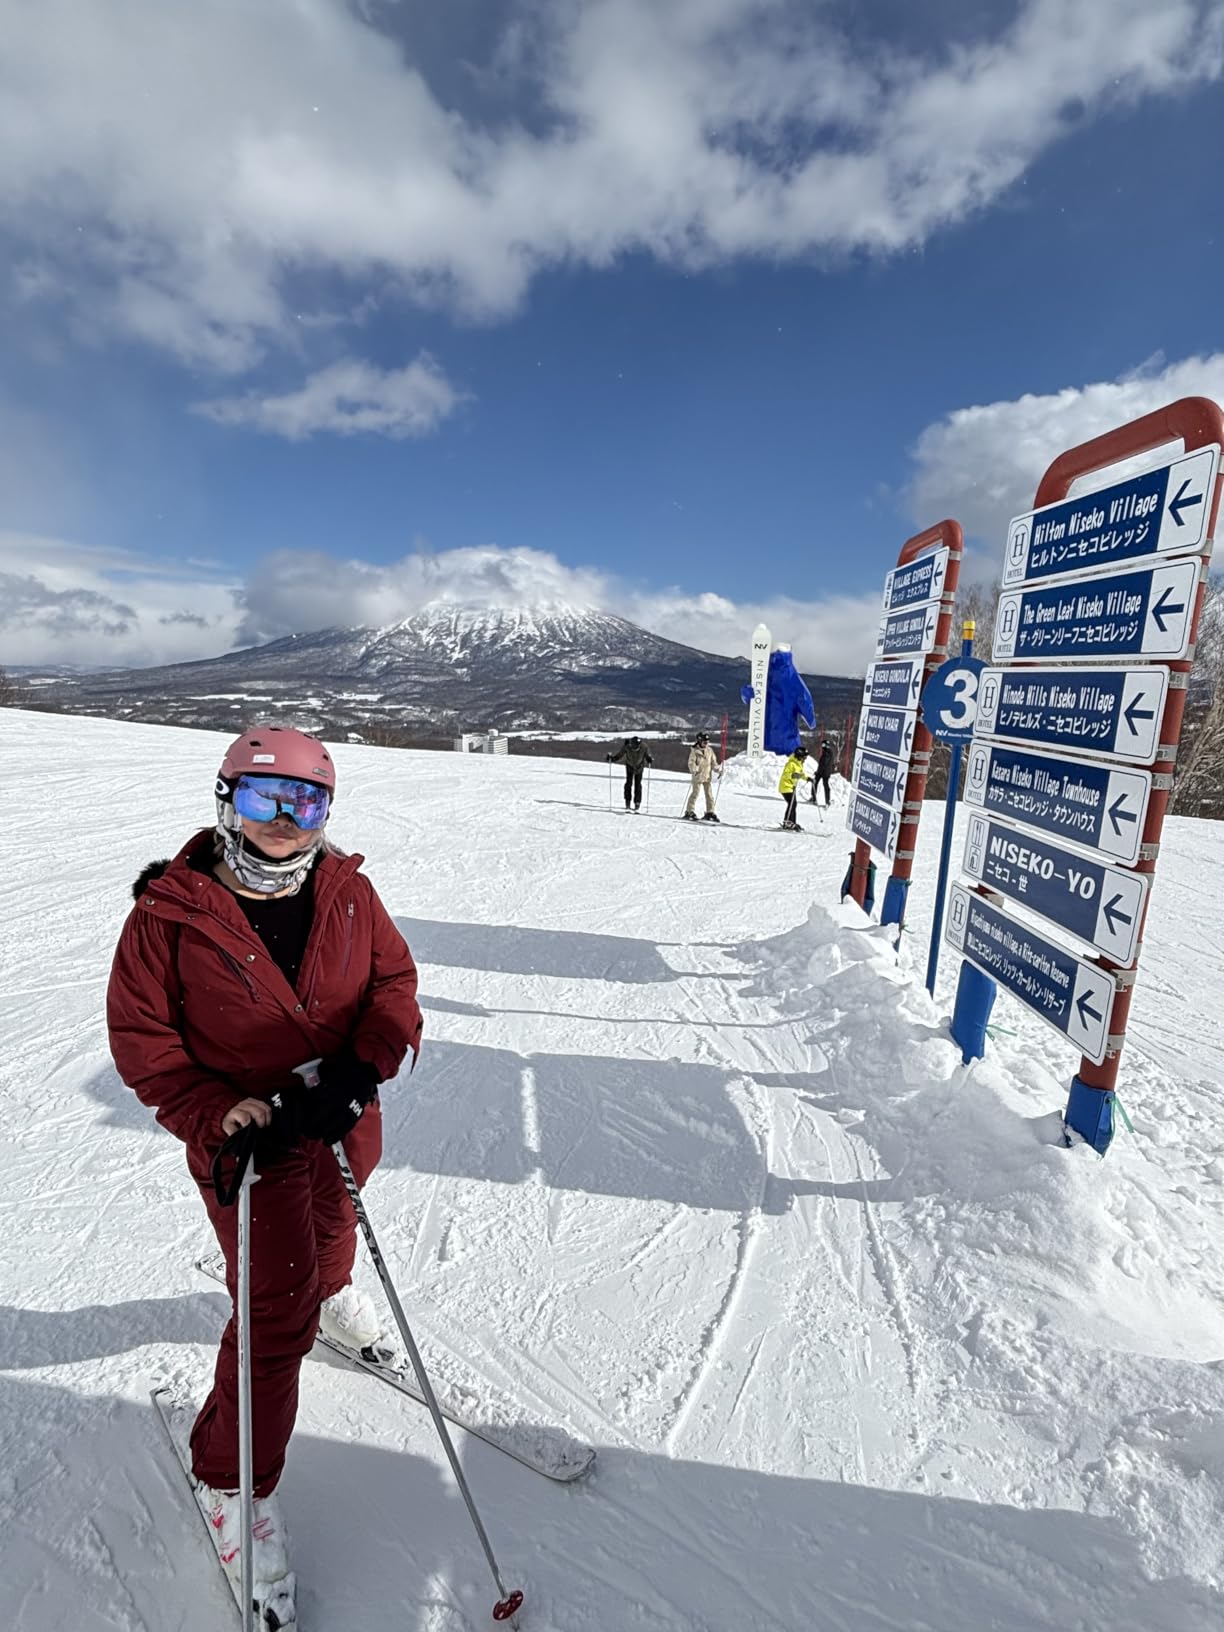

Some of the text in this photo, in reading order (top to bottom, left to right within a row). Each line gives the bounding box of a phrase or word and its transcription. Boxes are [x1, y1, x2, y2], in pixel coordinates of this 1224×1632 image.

[1033, 493, 1158, 546] Hilton Niseko Village
[1031, 521, 1149, 568] ヒルトンニセコビレッジ
[1023, 590, 1141, 624] The Green Leaf Niseko Village
[752, 660, 765, 757] NISEKO VILLAGE
[940, 669, 978, 729] 3
[1025, 685, 1047, 707] Hills
[1048, 685, 1076, 709] Niseko
[1079, 686, 1115, 714] Village
[999, 710, 1111, 738] ヒノデヒルズ・ニセコビレッジ
[1011, 765, 1032, 788] Niseko
[1033, 770, 1060, 797] Village
[1061, 775, 1100, 807] Townhouse
